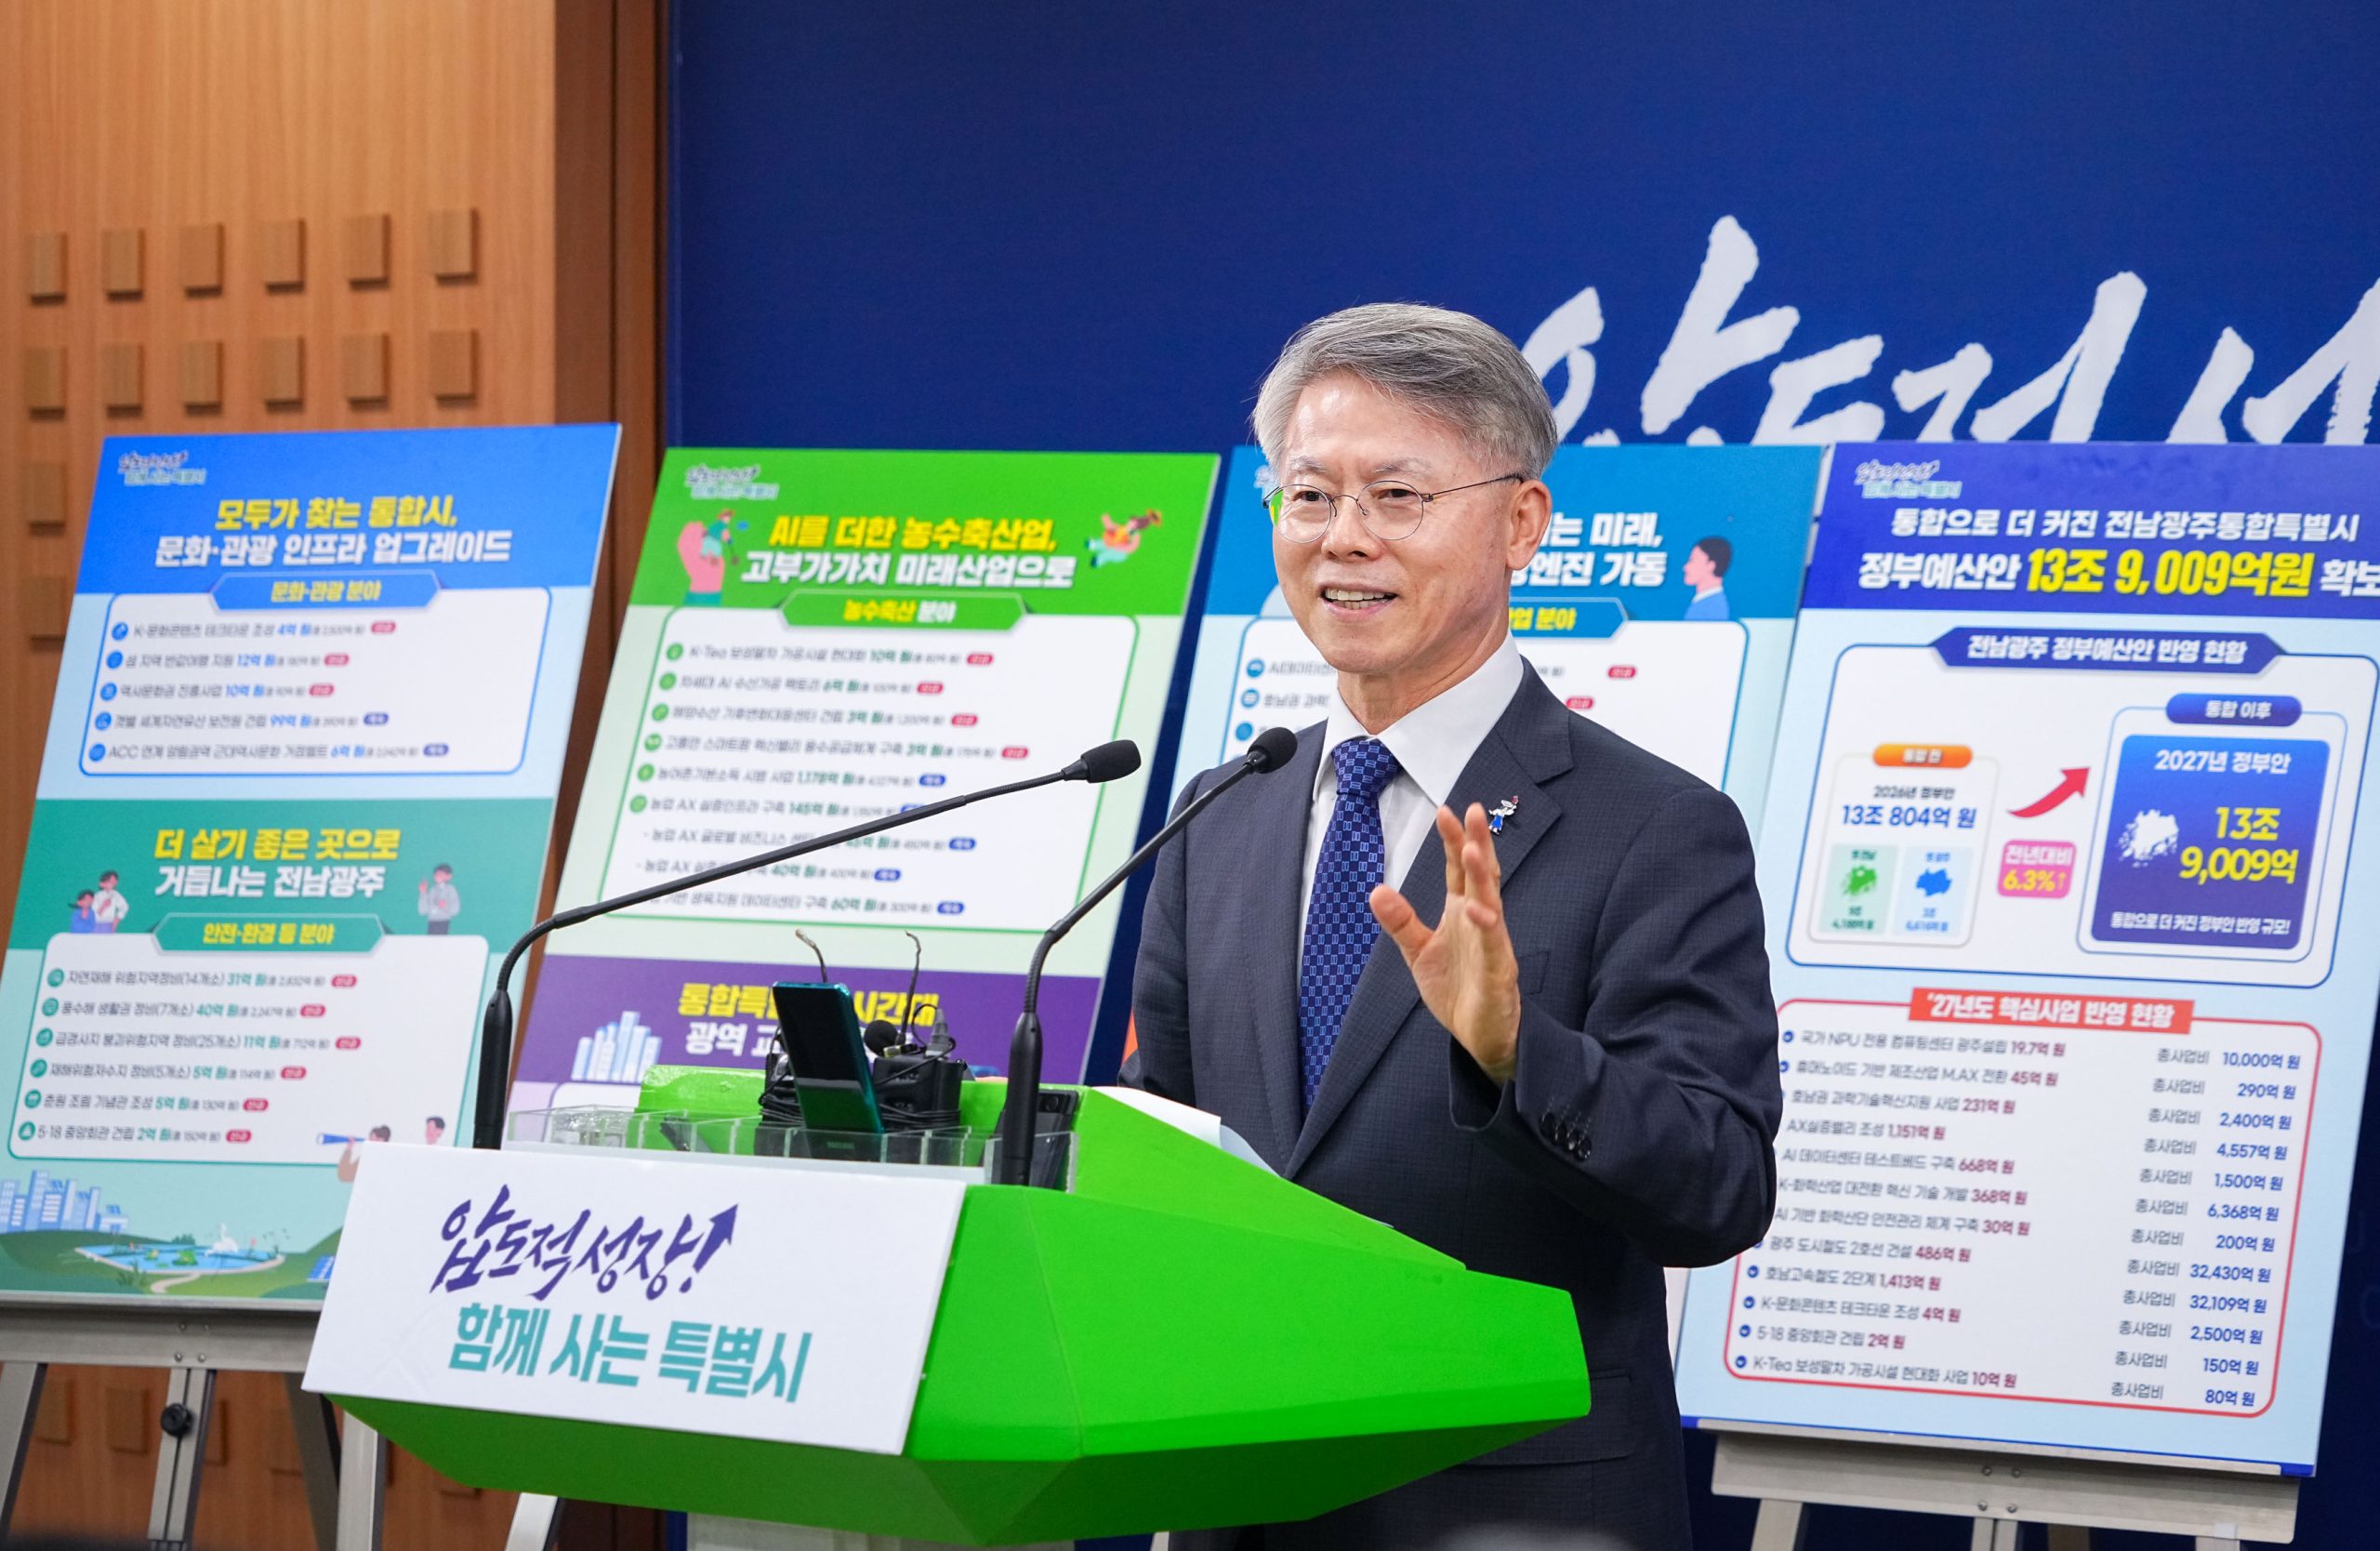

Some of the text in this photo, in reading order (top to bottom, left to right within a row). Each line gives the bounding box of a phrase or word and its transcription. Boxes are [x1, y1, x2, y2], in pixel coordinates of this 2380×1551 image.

[215, 495, 458, 530] 모두가 찾는 통합시,
[769, 515, 1057, 553] AI를 더한 농수축산업,
[1540, 512, 1662, 548] 는 미래,
[1891, 508, 2360, 542] 통합으로 더 커진 전남광주통합특별시
[284, 533, 366, 565] 인프라
[374, 530, 512, 563] 업그레이드
[742, 550, 1077, 588] 고부가가치 미래산업으로
[1600, 551, 1668, 587] 가동
[1859, 551, 2020, 590] 정부예산안
[2027, 549, 2108, 592] 13조
[2320, 558, 2380, 596] 확보
[347, 581, 381, 601] 분야
[843, 601, 956, 623] 농수축산 분야
[1536, 607, 1577, 630] 분야
[1968, 634, 2247, 665] 전남광주 정부예산안 반영 현황
[2205, 700, 2272, 719] 통합 이후
[2155, 749, 2292, 774] 2027년 정부안
[1842, 804, 1977, 829] 13조 804억 원
[2216, 807, 2281, 841] 13조
[154, 829, 401, 860] 더 살기 좋은 곳으로
[2005, 844, 2074, 866] 전년대비
[2180, 846, 2299, 885] 9,009억
[155, 866, 385, 897] 거듭나는 전남광주
[299, 924, 335, 944] 분야
[2111, 912, 2291, 935] 통합으로 더 커진 정부안 반영 규모!
[2000, 997, 2082, 1024] 핵심사업
[2084, 1001, 2128, 1026] 반영
[2131, 1004, 2175, 1028] 현황
[685, 1021, 747, 1057] 광역
[1829, 1033, 1859, 1047] NPU
[2011, 1041, 2049, 1055] 19.7억
[2053, 1043, 2066, 1057] 원
[2157, 1048, 2300, 1069] 총사업비 10,000억 원
[2011, 1071, 2042, 1085] 45억
[2152, 1078, 2295, 1100] 총사업비 290억 원
[1963, 1098, 1999, 1113] 231억
[2149, 1108, 2292, 1130] 총사업비 2,400억 원
[2144, 1138, 2287, 1160] 총사업비 4,557억 원
[2139, 1169, 2283, 1190] 총사업비 1,500억 원
[2135, 1199, 2279, 1221] 총사업비 6,368억 원
[2131, 1229, 2275, 1252] 총사업비 200억 원
[1916, 1245, 1954, 1260] 486억
[1959, 1248, 1971, 1262] 원
[1880, 1274, 1924, 1289] 1,413억
[1928, 1277, 1941, 1291] 원
[2127, 1259, 2270, 1282] 총사업비 32,430억 원
[2123, 1290, 2267, 1313] 총사업비 32,109억 원
[1924, 1307, 1945, 1321] 4억
[1949, 1308, 1961, 1322] 원
[1868, 1333, 1888, 1348] 2억
[1893, 1335, 1905, 1349] 원
[2119, 1320, 2263, 1344] 총사업비 2,500억 원
[448, 1303, 813, 1403] 함께 사는 특별시
[2115, 1351, 2258, 1375] 총사업비 150억 원
[1753, 1357, 1792, 1372] K-Tea
[1972, 1371, 2001, 1386] 10억
[2004, 1374, 2016, 1388] 원
[2111, 1382, 2254, 1407] 총사업비 80억 원
